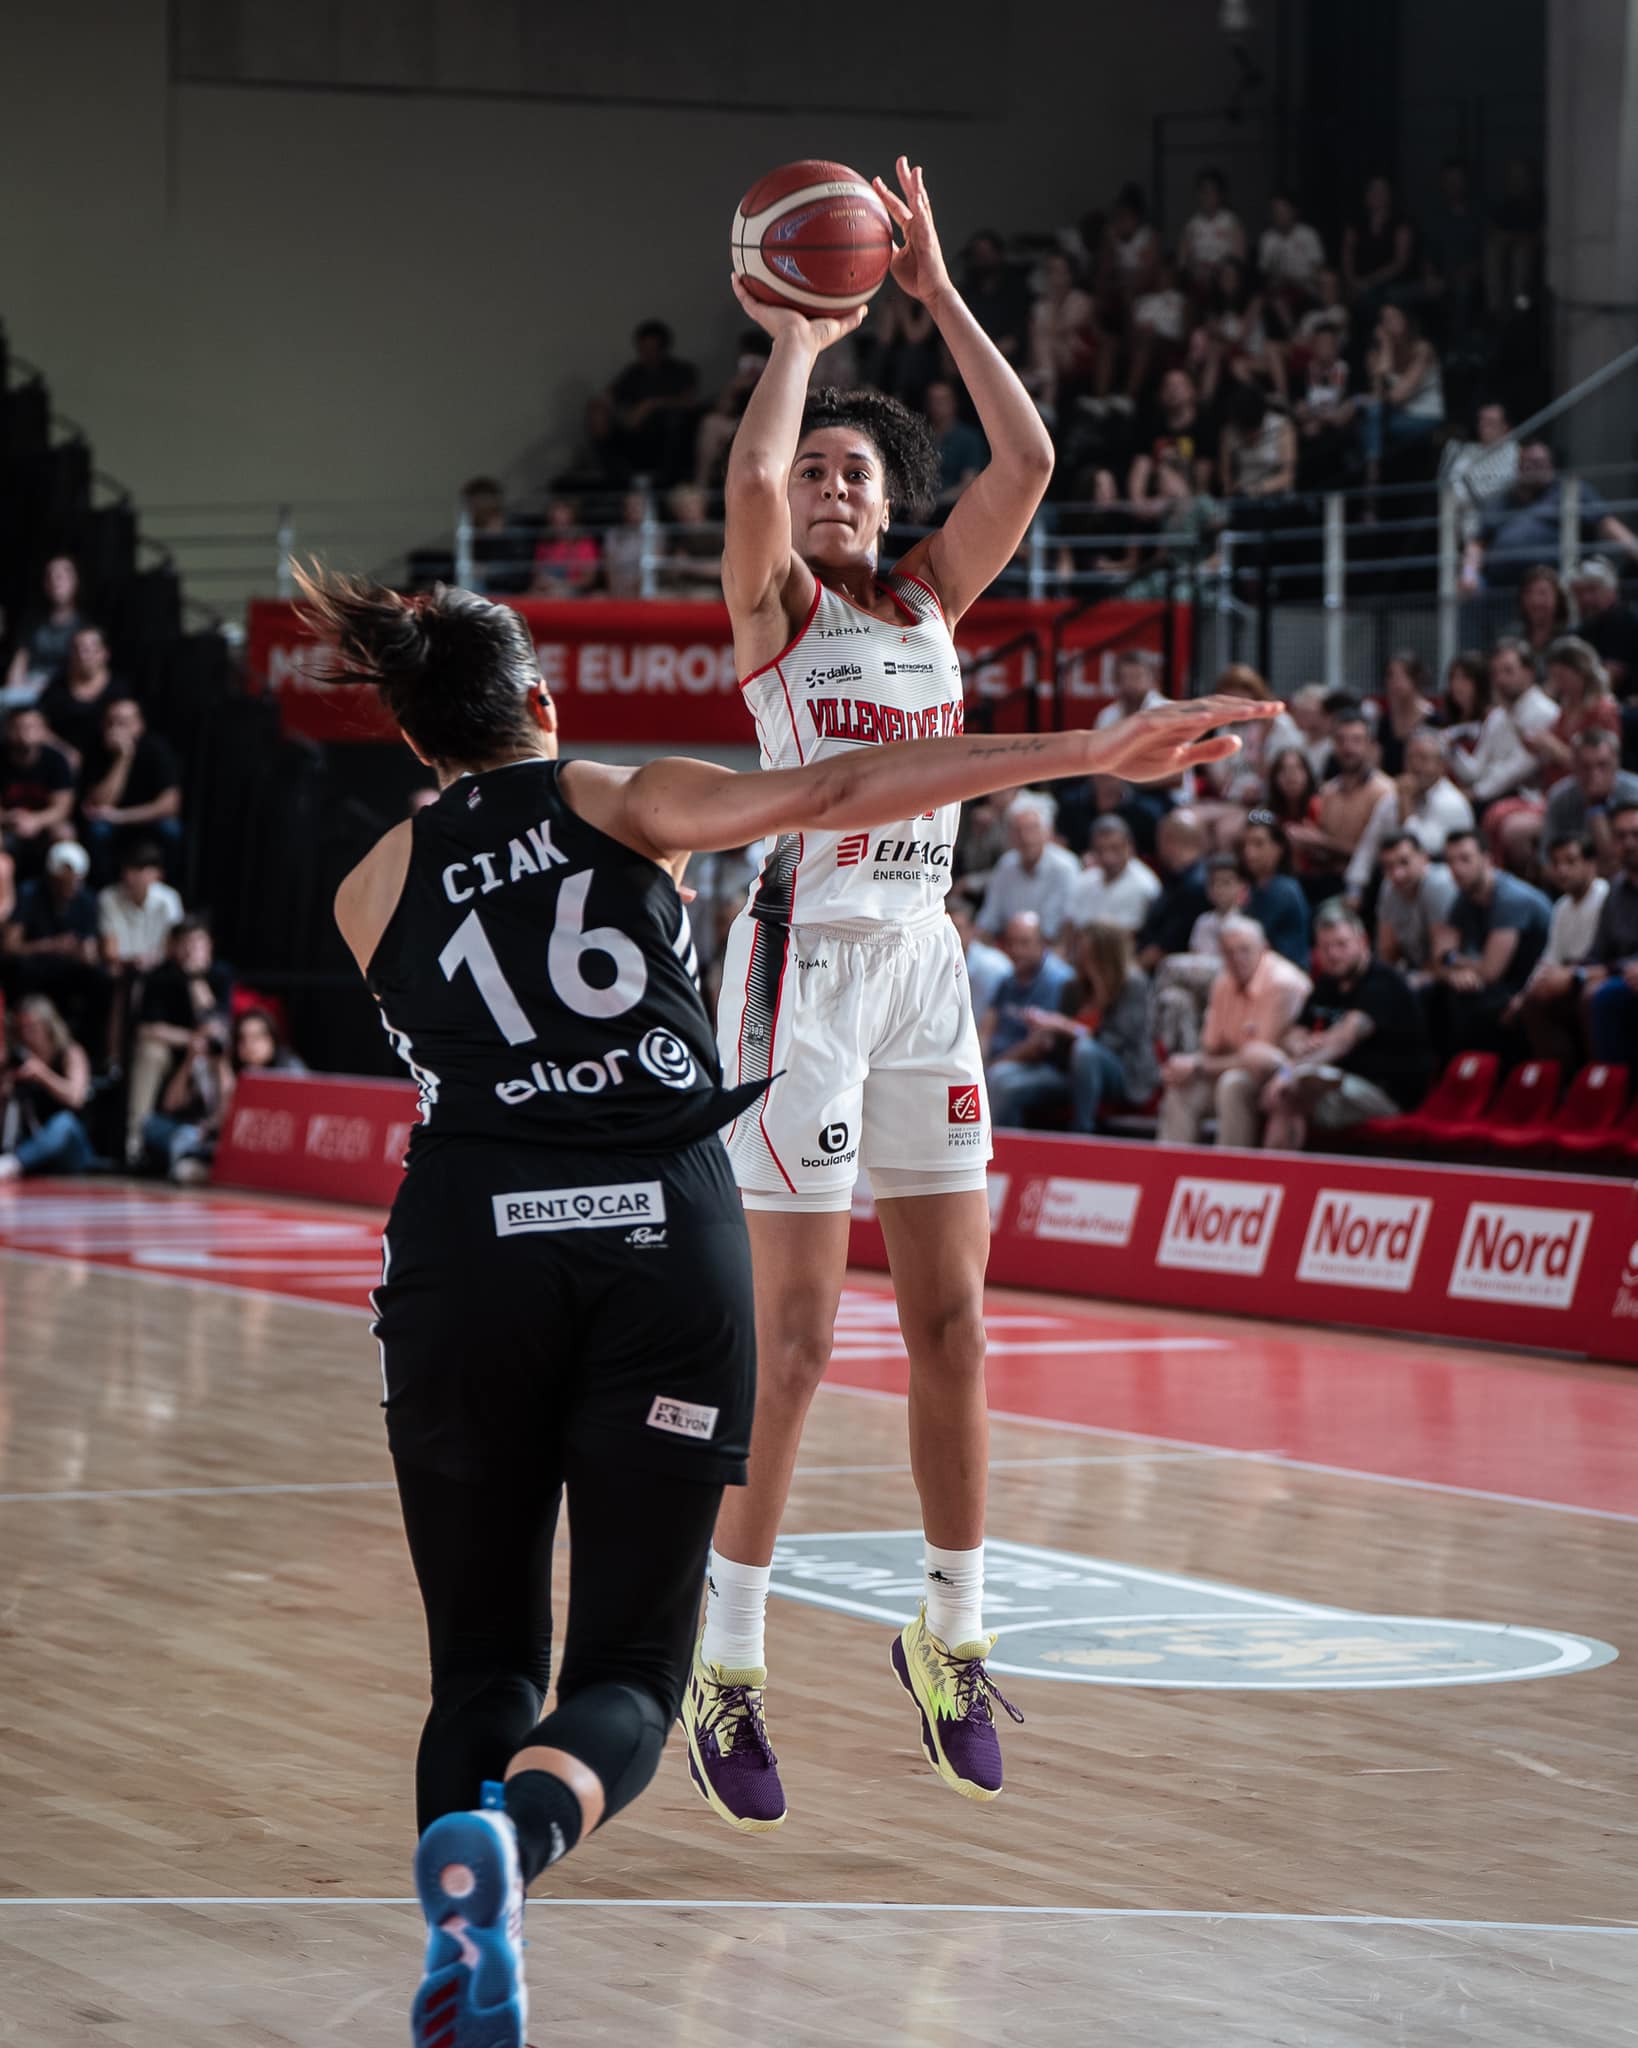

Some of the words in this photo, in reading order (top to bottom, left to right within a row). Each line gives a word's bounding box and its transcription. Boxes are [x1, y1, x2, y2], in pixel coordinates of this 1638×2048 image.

[818, 625, 872, 640] TARMAK
[577, 644, 738, 694] EURO
[827, 663, 862, 680] dalkia
[442, 819, 570, 904] CIAK
[873, 839, 951, 867] EIFAG
[438, 868, 648, 1046] 16
[495, 1049, 629, 1105] elior
[801, 1148, 857, 1168] boulange
[506, 1199, 567, 1221] RENT
[599, 1193, 650, 1214] CAR
[1172, 1188, 1272, 1246] Nord
[1313, 1202, 1420, 1263] Nord
[1465, 1215, 1579, 1279] Nord
[676, 1415, 710, 1433] LYON
